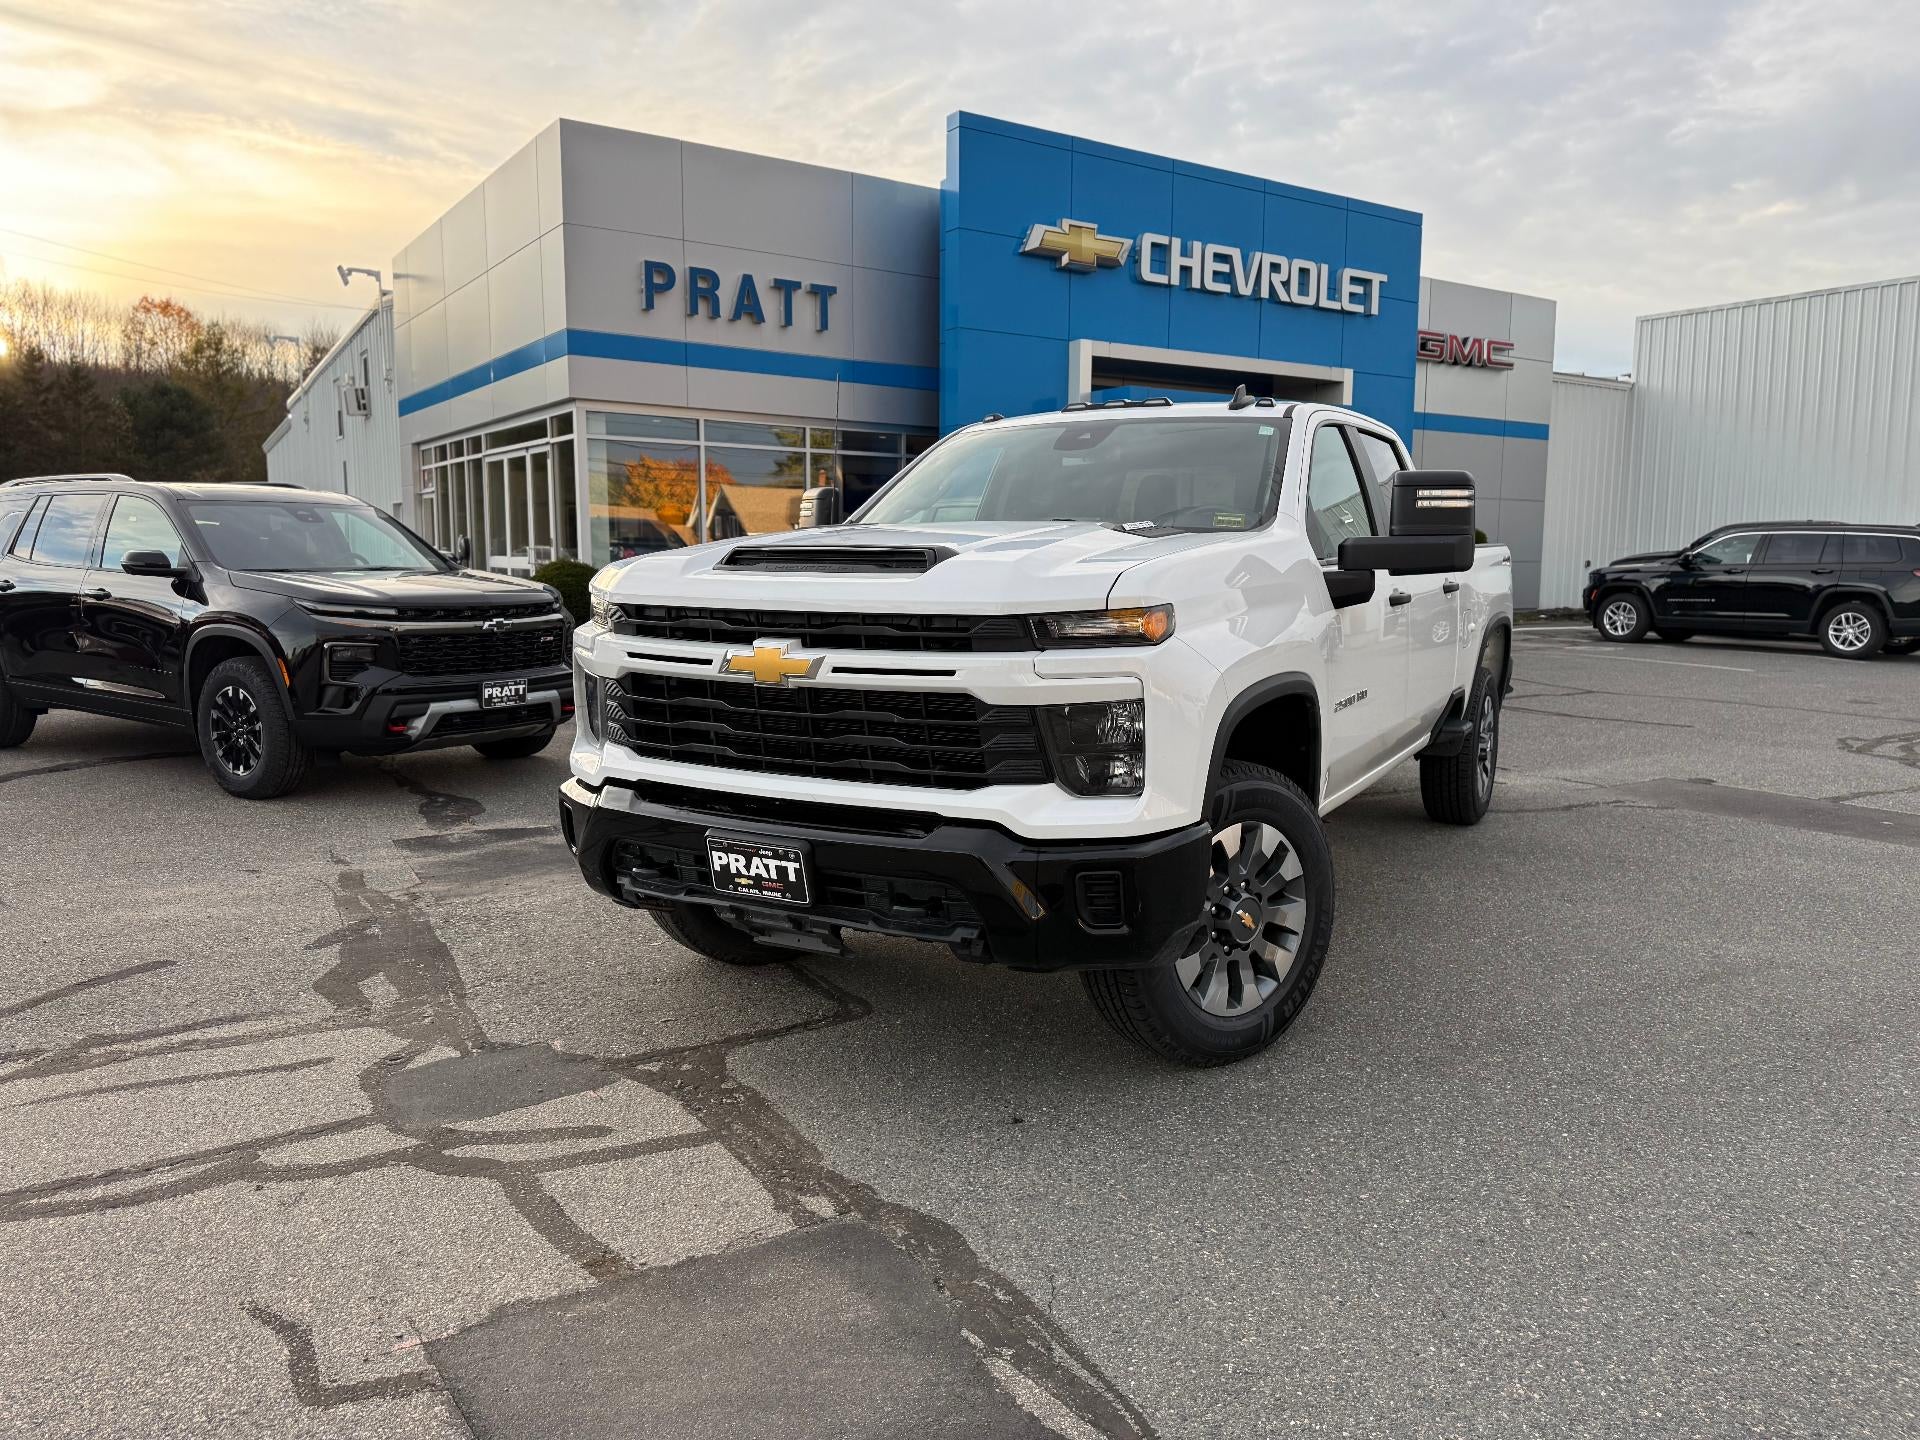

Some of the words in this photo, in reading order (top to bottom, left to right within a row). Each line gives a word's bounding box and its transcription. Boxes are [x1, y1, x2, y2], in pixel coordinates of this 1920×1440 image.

[1138, 232, 1388, 316] CHEVROLET
[641, 259, 837, 332] PRATT
[1416, 329, 1515, 369] GMC
[484, 685, 526, 698] PRATT
[711, 851, 800, 882] PRATT
[758, 849, 773, 857] Jeep
